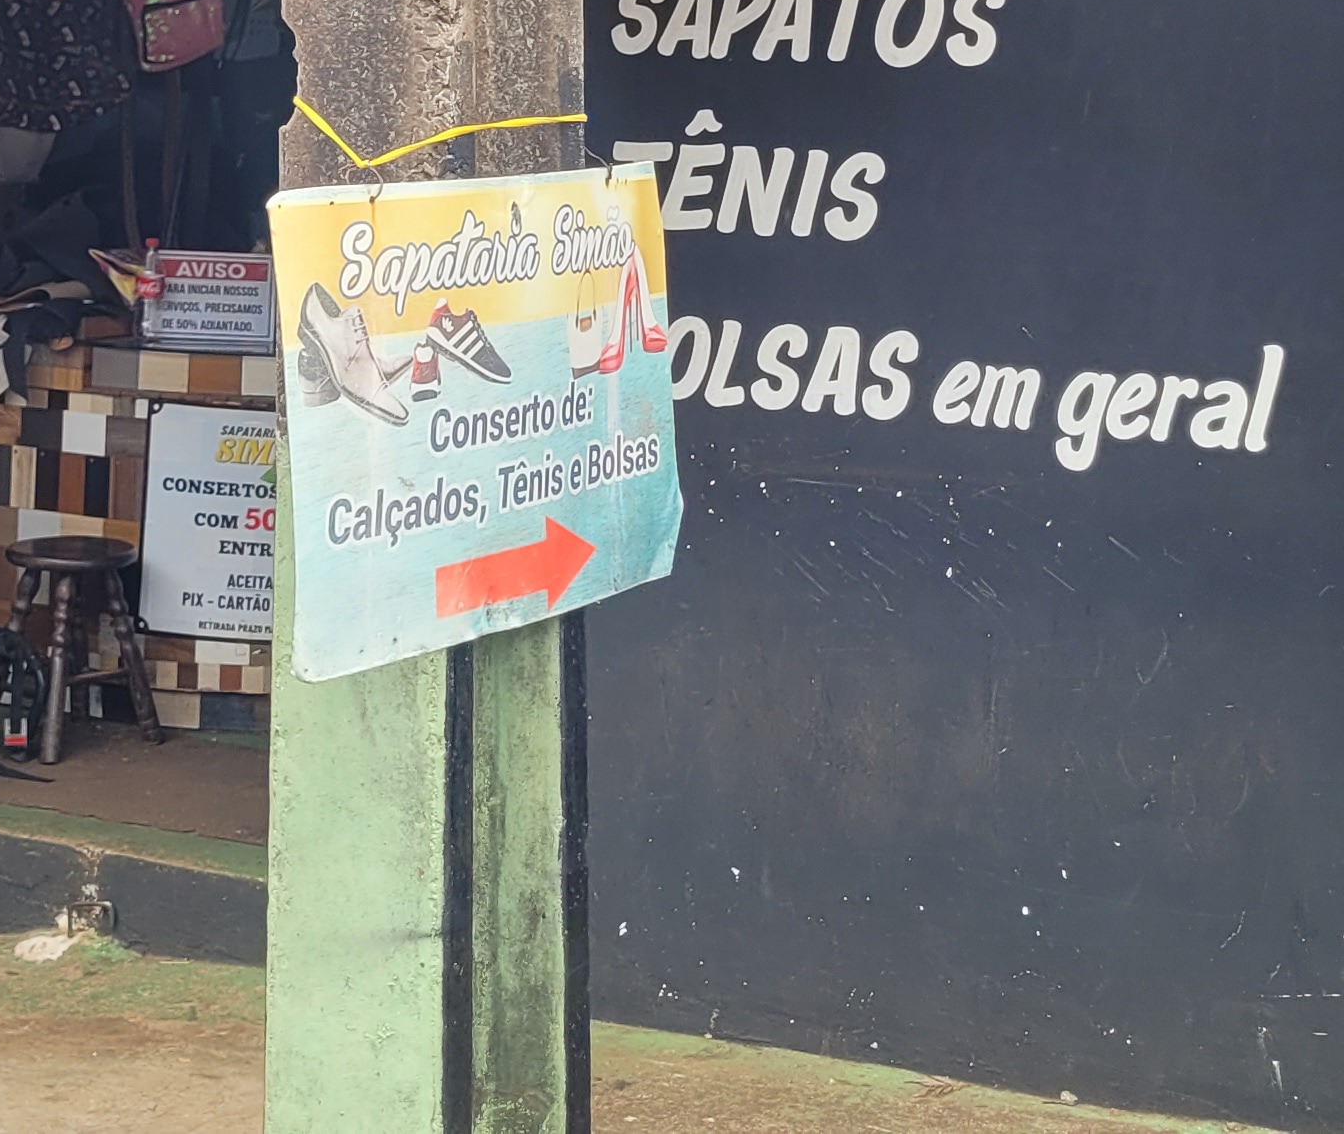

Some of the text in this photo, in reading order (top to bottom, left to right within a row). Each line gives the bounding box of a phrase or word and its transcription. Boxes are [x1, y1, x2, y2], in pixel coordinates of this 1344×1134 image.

[339, 204, 636, 316] Sapataria Simão
[175, 261, 246, 279] AVISO
[188, 284, 221, 295] INICIAR
[223, 286, 259, 297] NOSSOS
[204, 303, 263, 315] PRECISAMOS
[162, 318, 255, 332] DE 50% ADIANTADO.
[670, 315, 1285, 472] OLSAS em geral
[430, 381, 594, 454] Conserto de:
[215, 438, 277, 466] SIM
[162, 477, 277, 500] CONSERTOS
[327, 435, 659, 548] Calçados, Tênis e Bolsas
[194, 512, 239, 530] COM
[218, 540, 274, 557] ENTR
[226, 574, 274, 590] ACEITA
[182, 591, 204, 608] PIX
[217, 593, 271, 612] CARTÃO
[198, 620, 236, 632] RETIRADA
[238, 623, 263, 634] PRAZO
